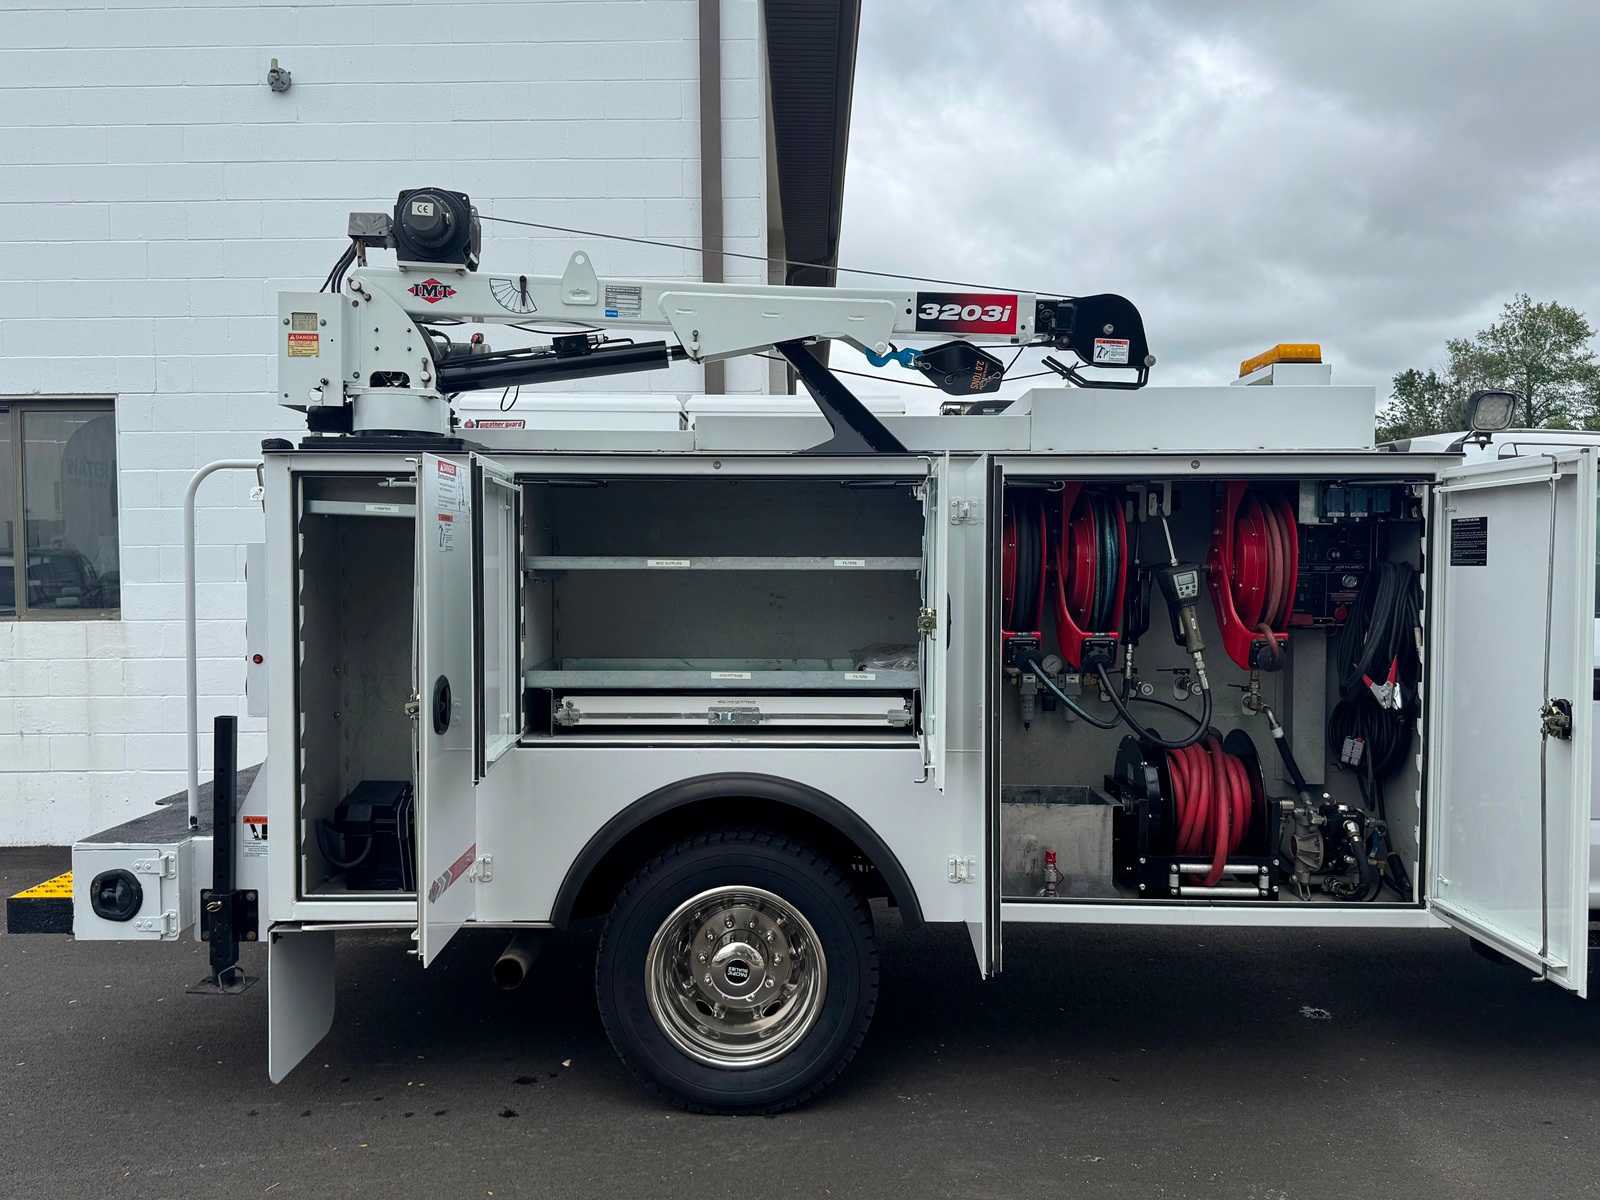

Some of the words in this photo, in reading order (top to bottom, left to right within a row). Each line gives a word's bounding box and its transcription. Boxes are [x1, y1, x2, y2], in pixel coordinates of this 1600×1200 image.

[417, 204, 429, 214] CE
[414, 284, 451, 298] IMT
[918, 303, 1012, 322] 3203i
[975, 360, 985, 371] 2.0
[970, 372, 982, 390] TONS
